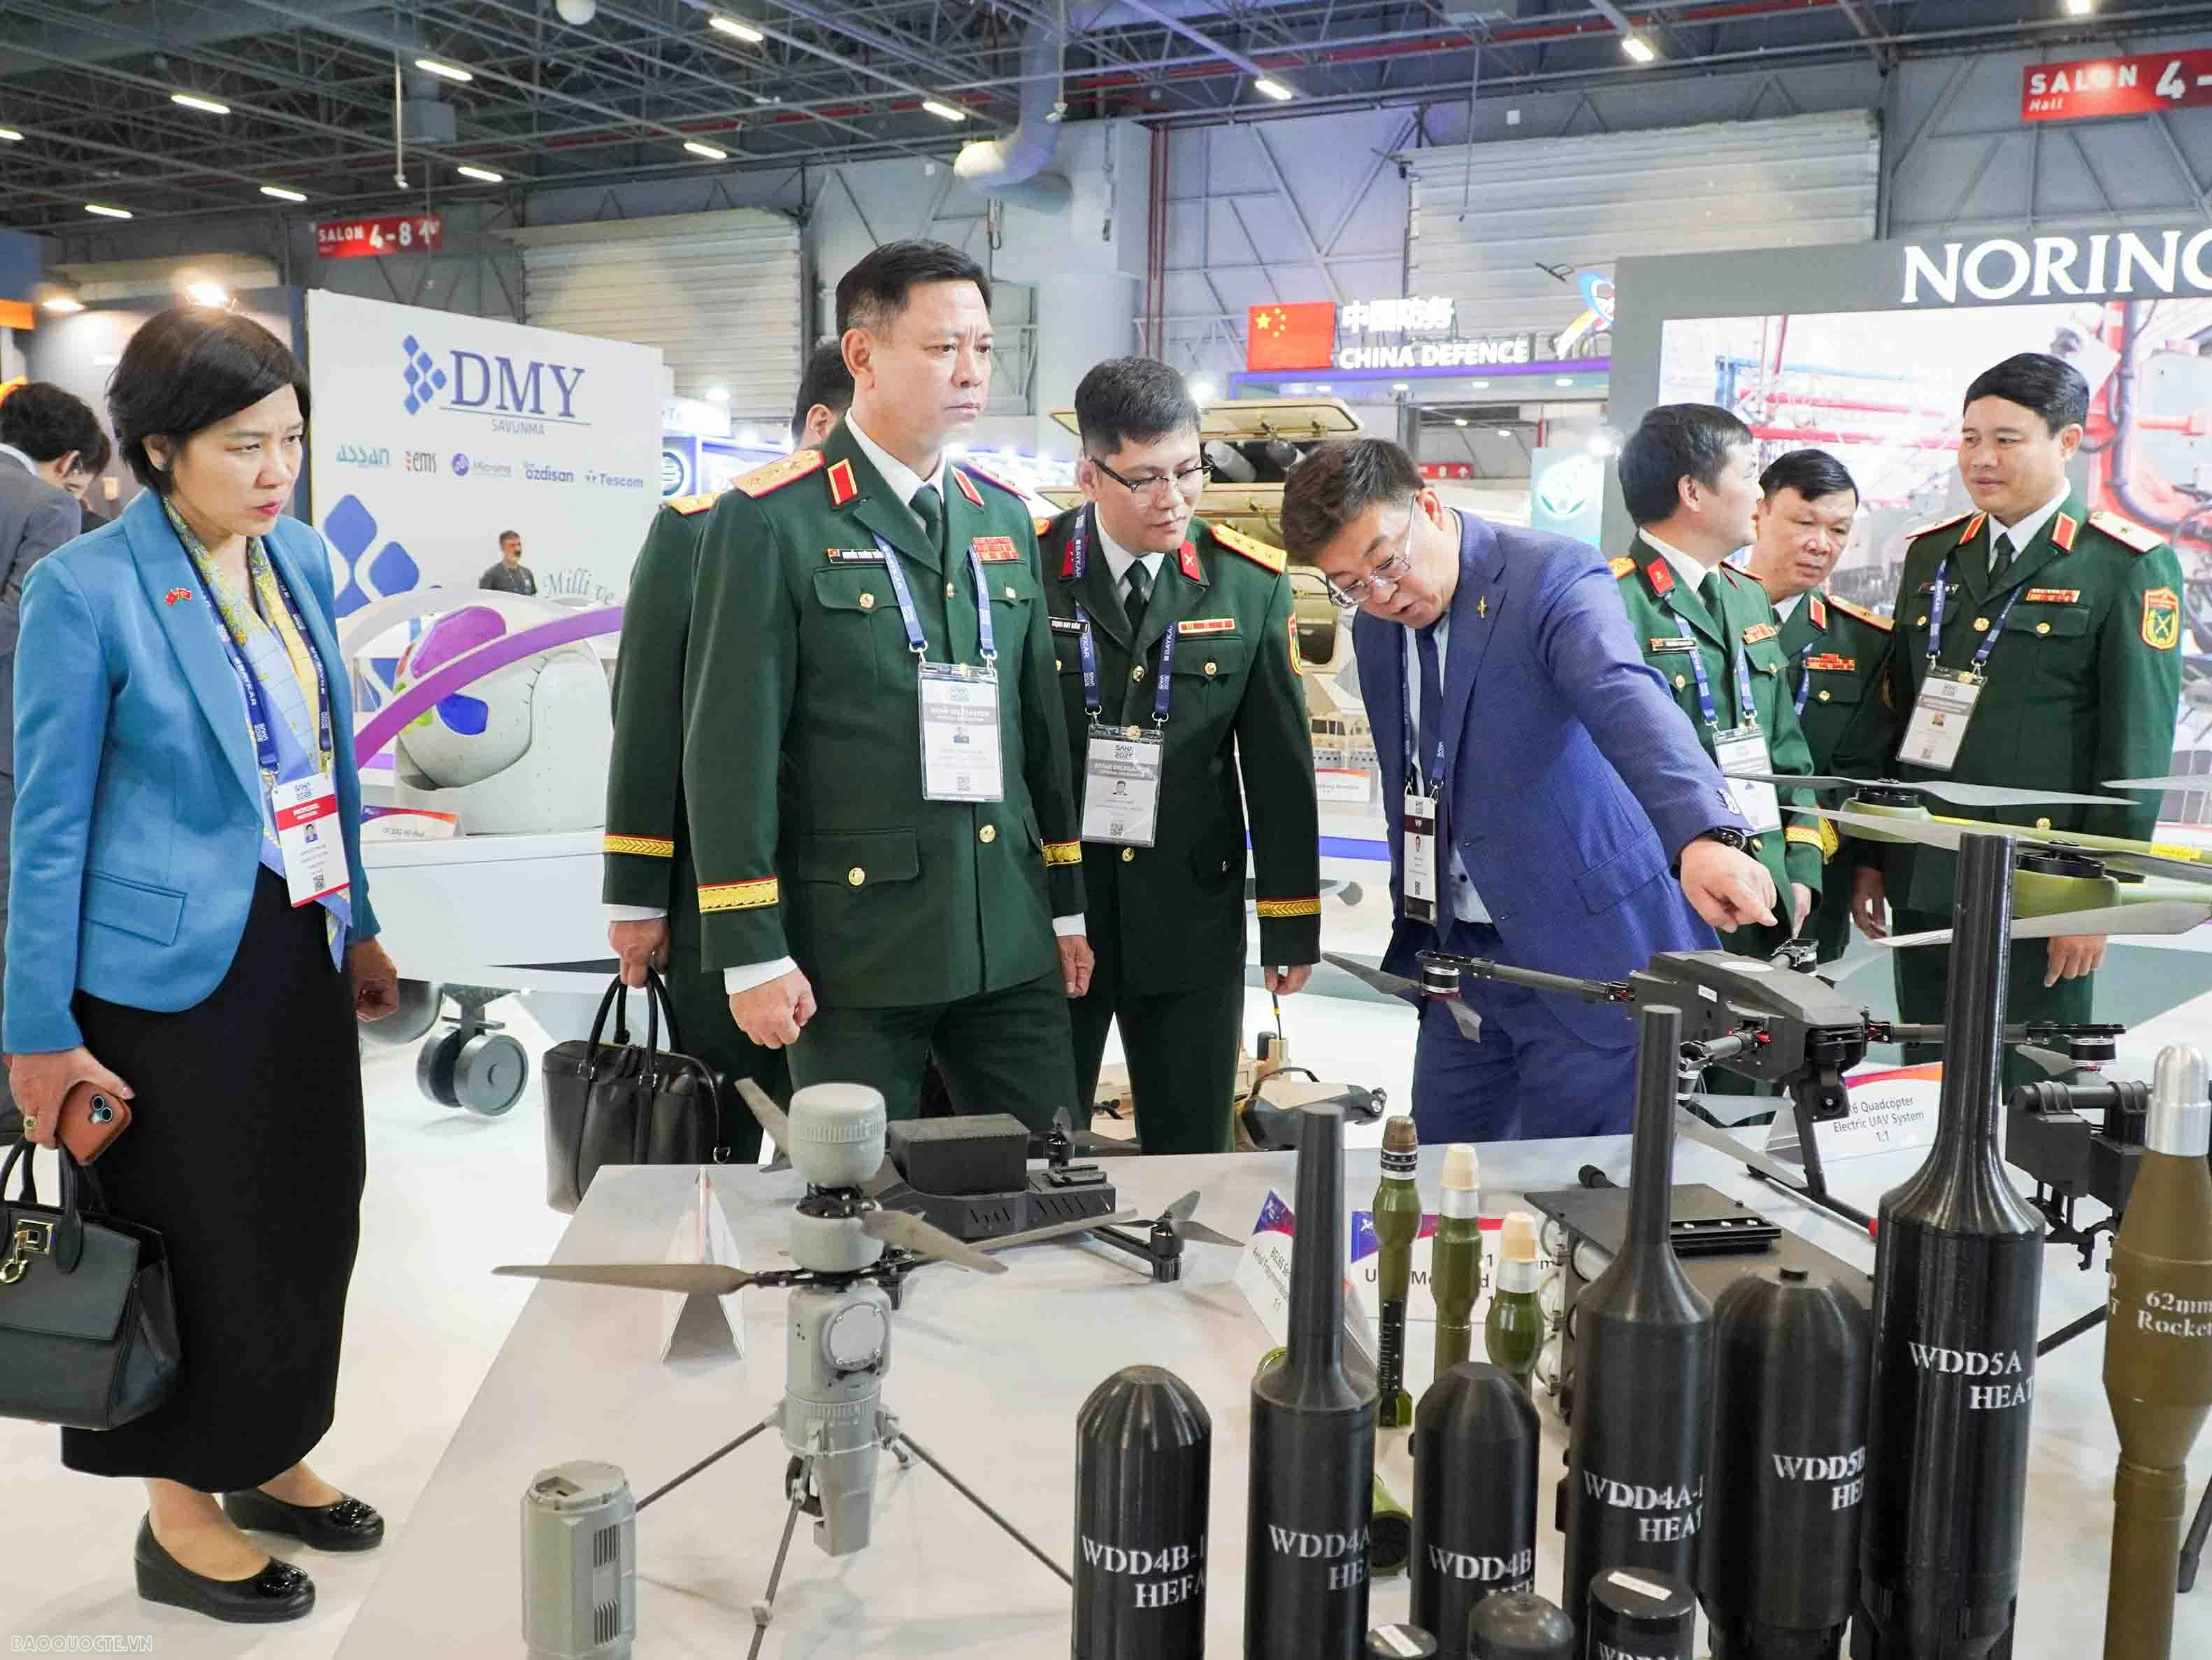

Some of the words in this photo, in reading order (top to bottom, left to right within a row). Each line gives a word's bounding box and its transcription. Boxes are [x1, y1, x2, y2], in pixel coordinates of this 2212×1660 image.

[2030, 64, 2136, 95] SALON
[2029, 96, 2063, 112] Hall
[318, 218, 364, 243] SALON
[1339, 346, 1415, 369] CHINA
[1422, 340, 1528, 366] DEFENCE
[450, 349, 586, 419] DMY
[491, 419, 545, 435] SAVUNMA
[599, 473, 643, 488] Tescom
[1861, 1097, 1914, 1113] Quadcopter
[1834, 1118, 1867, 1132] Electric
[1869, 1113, 1889, 1127] UAV
[1891, 1111, 1924, 1126] System
[1909, 1341, 2023, 1375] WDD5A
